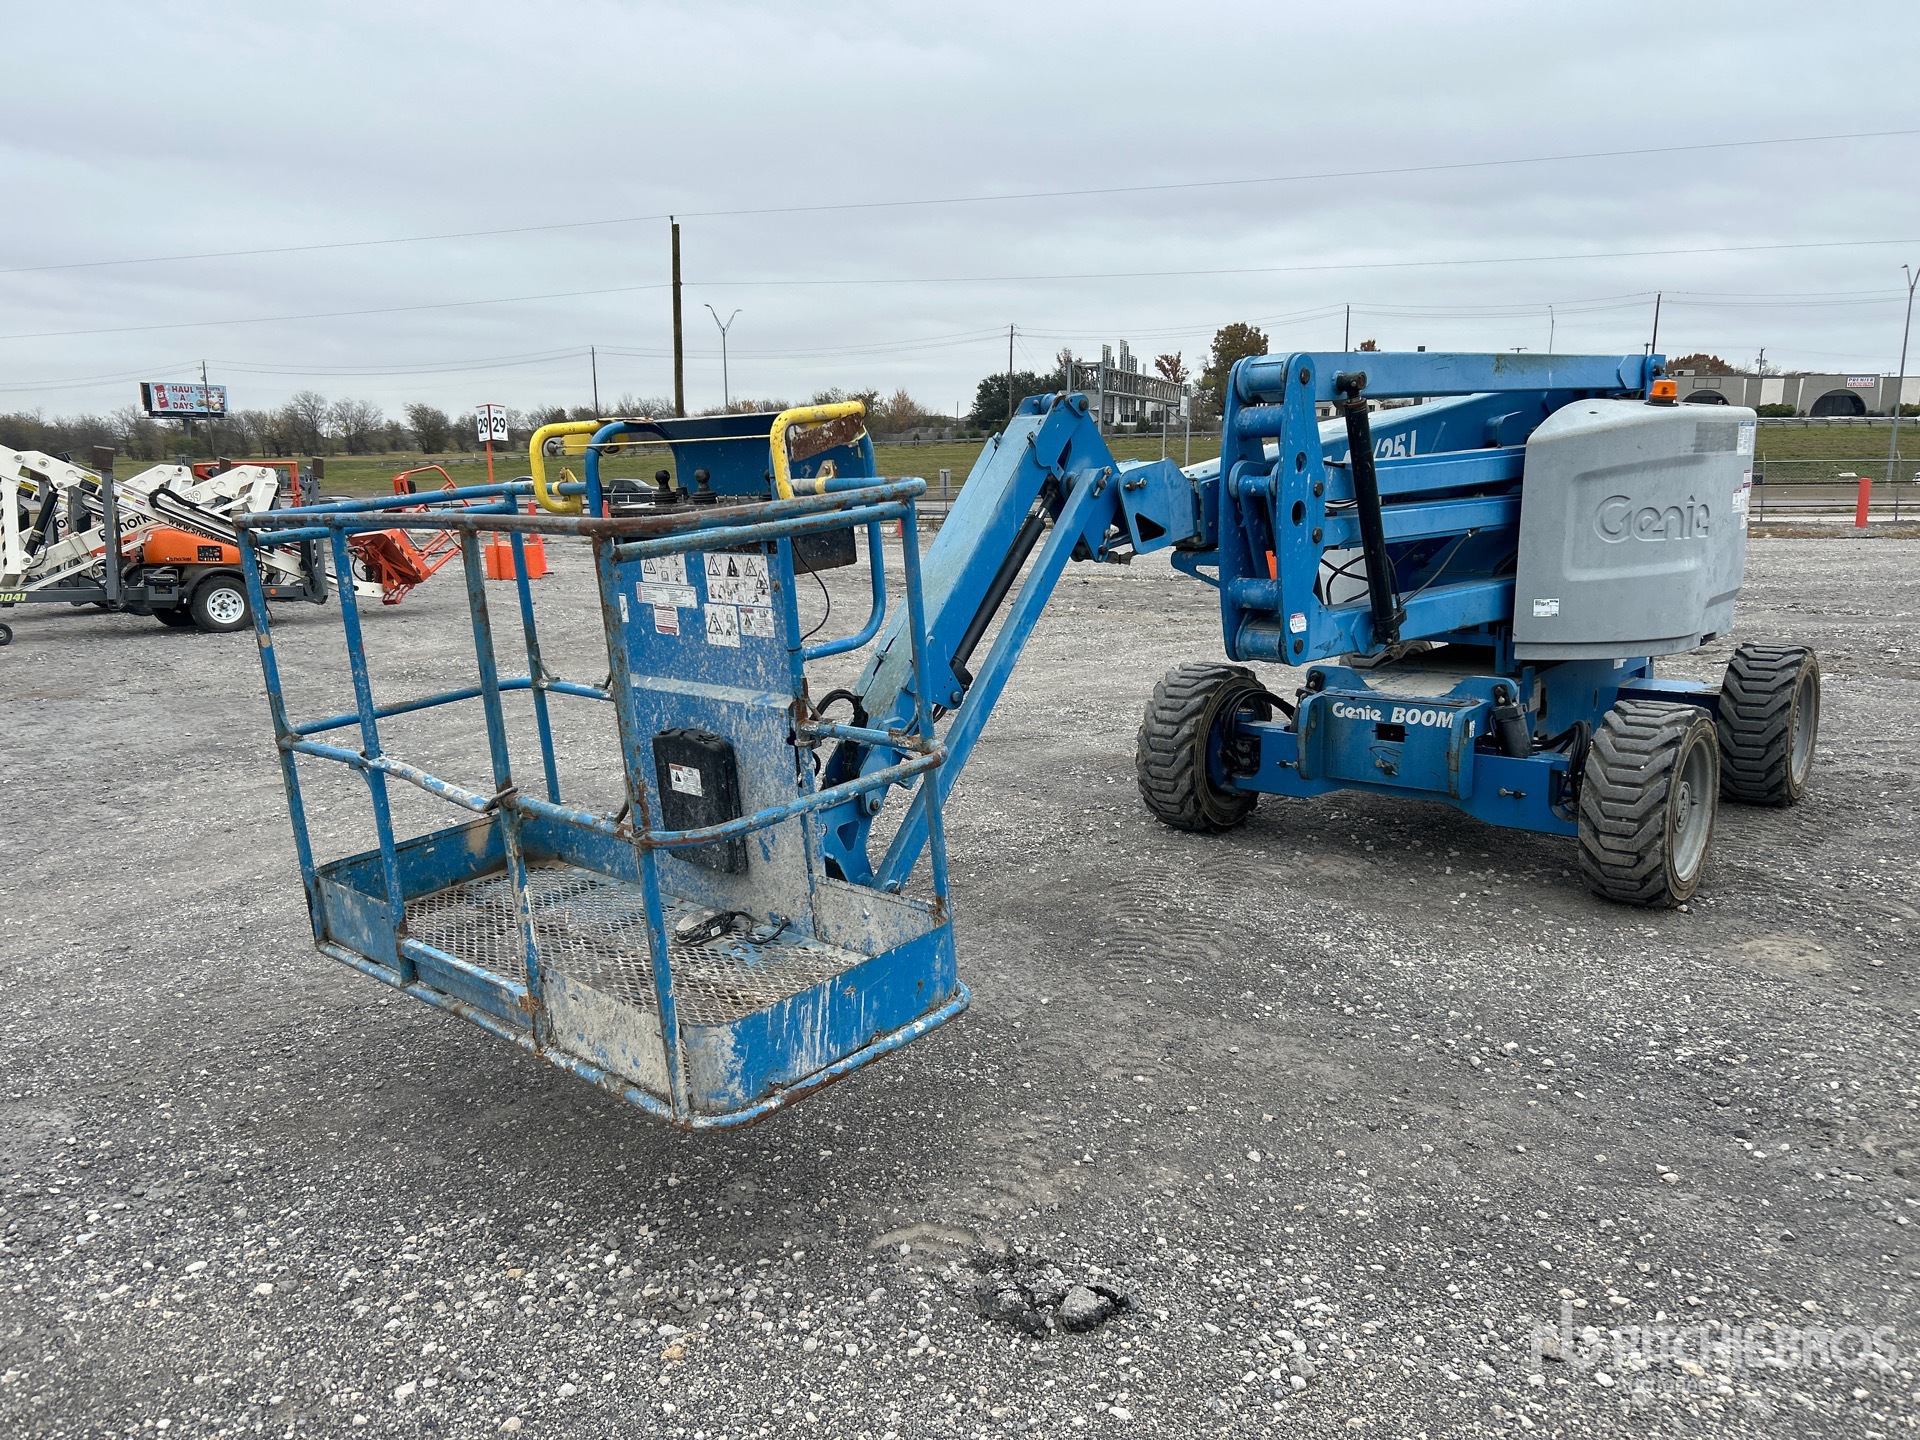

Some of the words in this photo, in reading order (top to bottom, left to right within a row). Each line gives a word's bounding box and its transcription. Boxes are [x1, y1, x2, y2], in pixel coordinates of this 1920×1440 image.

[171, 385, 194, 393] HAUL
[172, 402, 194, 410] DAYS
[478, 417, 488, 434] 29
[492, 416, 506, 434] 29
[1592, 494, 1711, 545] Genie
[1331, 701, 1383, 722] Genie
[1390, 706, 1455, 729] BOOM
